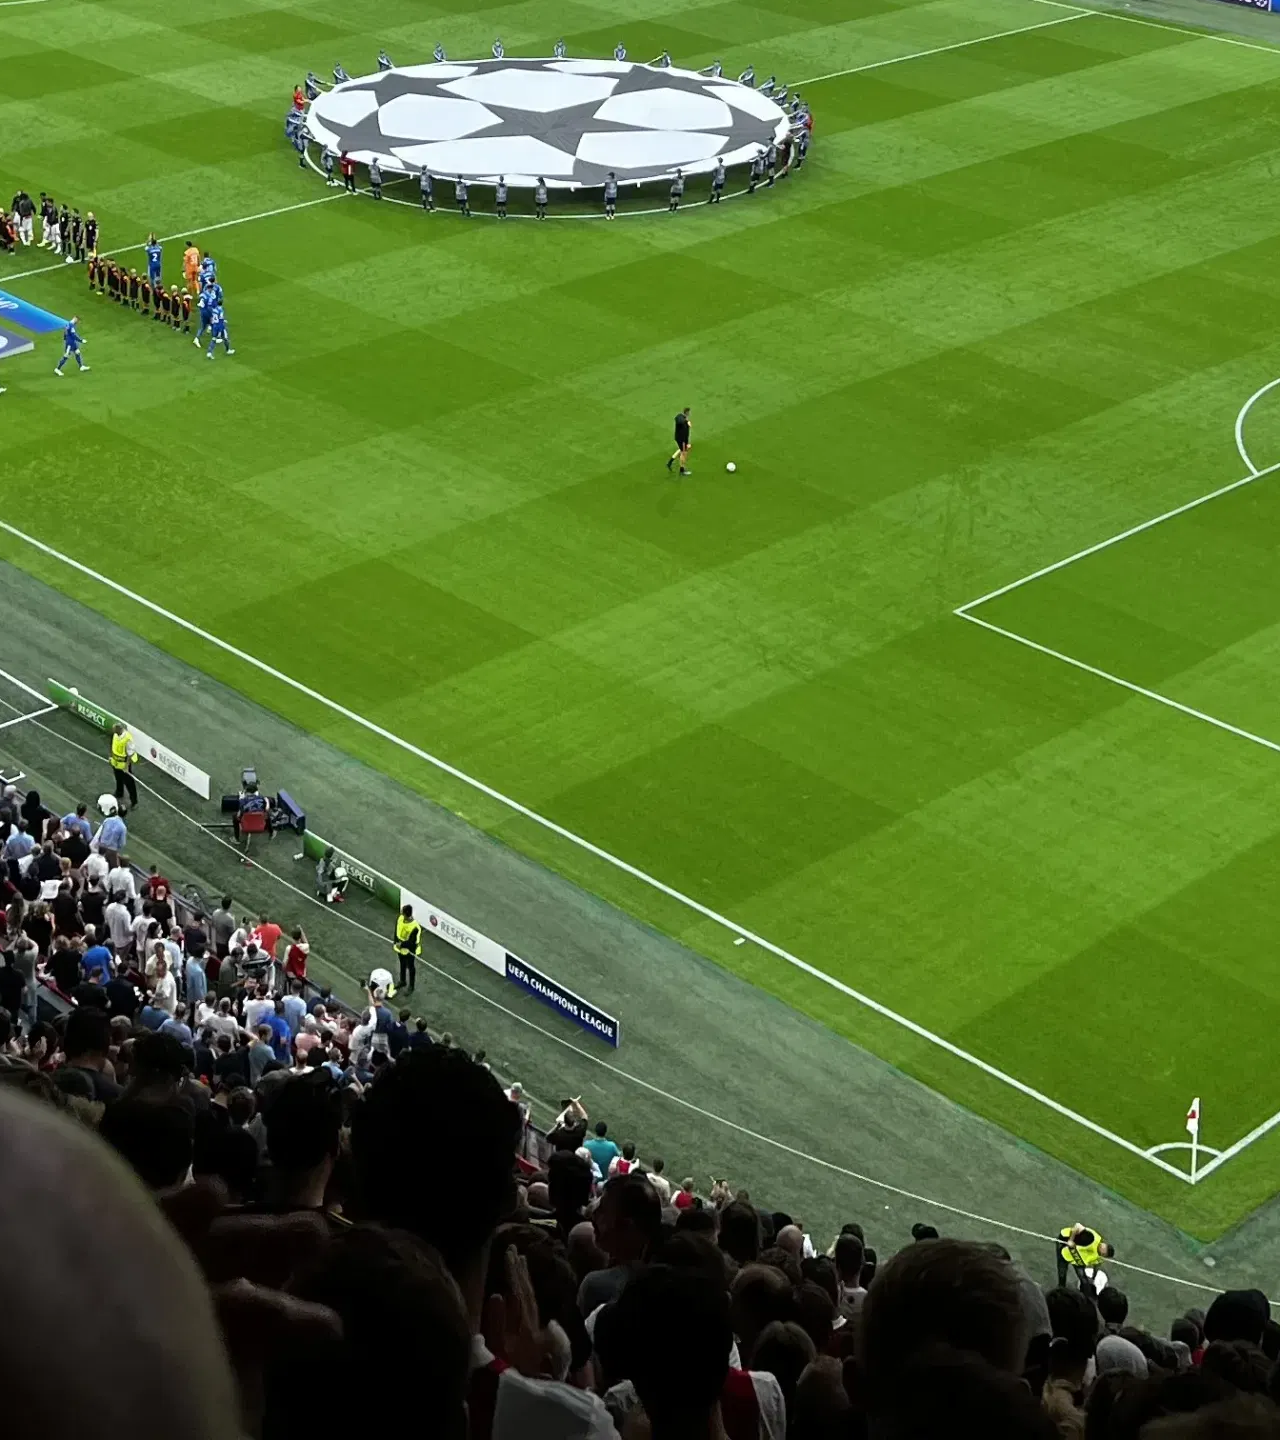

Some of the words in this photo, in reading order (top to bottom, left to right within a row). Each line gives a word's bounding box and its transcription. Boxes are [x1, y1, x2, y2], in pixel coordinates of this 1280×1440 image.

[152, 252, 158, 262] 2
[78, 703, 106, 727] RESPECT
[158, 752, 186, 777] RESPECT
[341, 859, 375, 889] RESPECT
[440, 920, 477, 951] RESPECT
[508, 962, 530, 985] UEFA
[530, 978, 578, 1016] CHAMPIONS
[580, 1009, 614, 1038] LEAGUE
